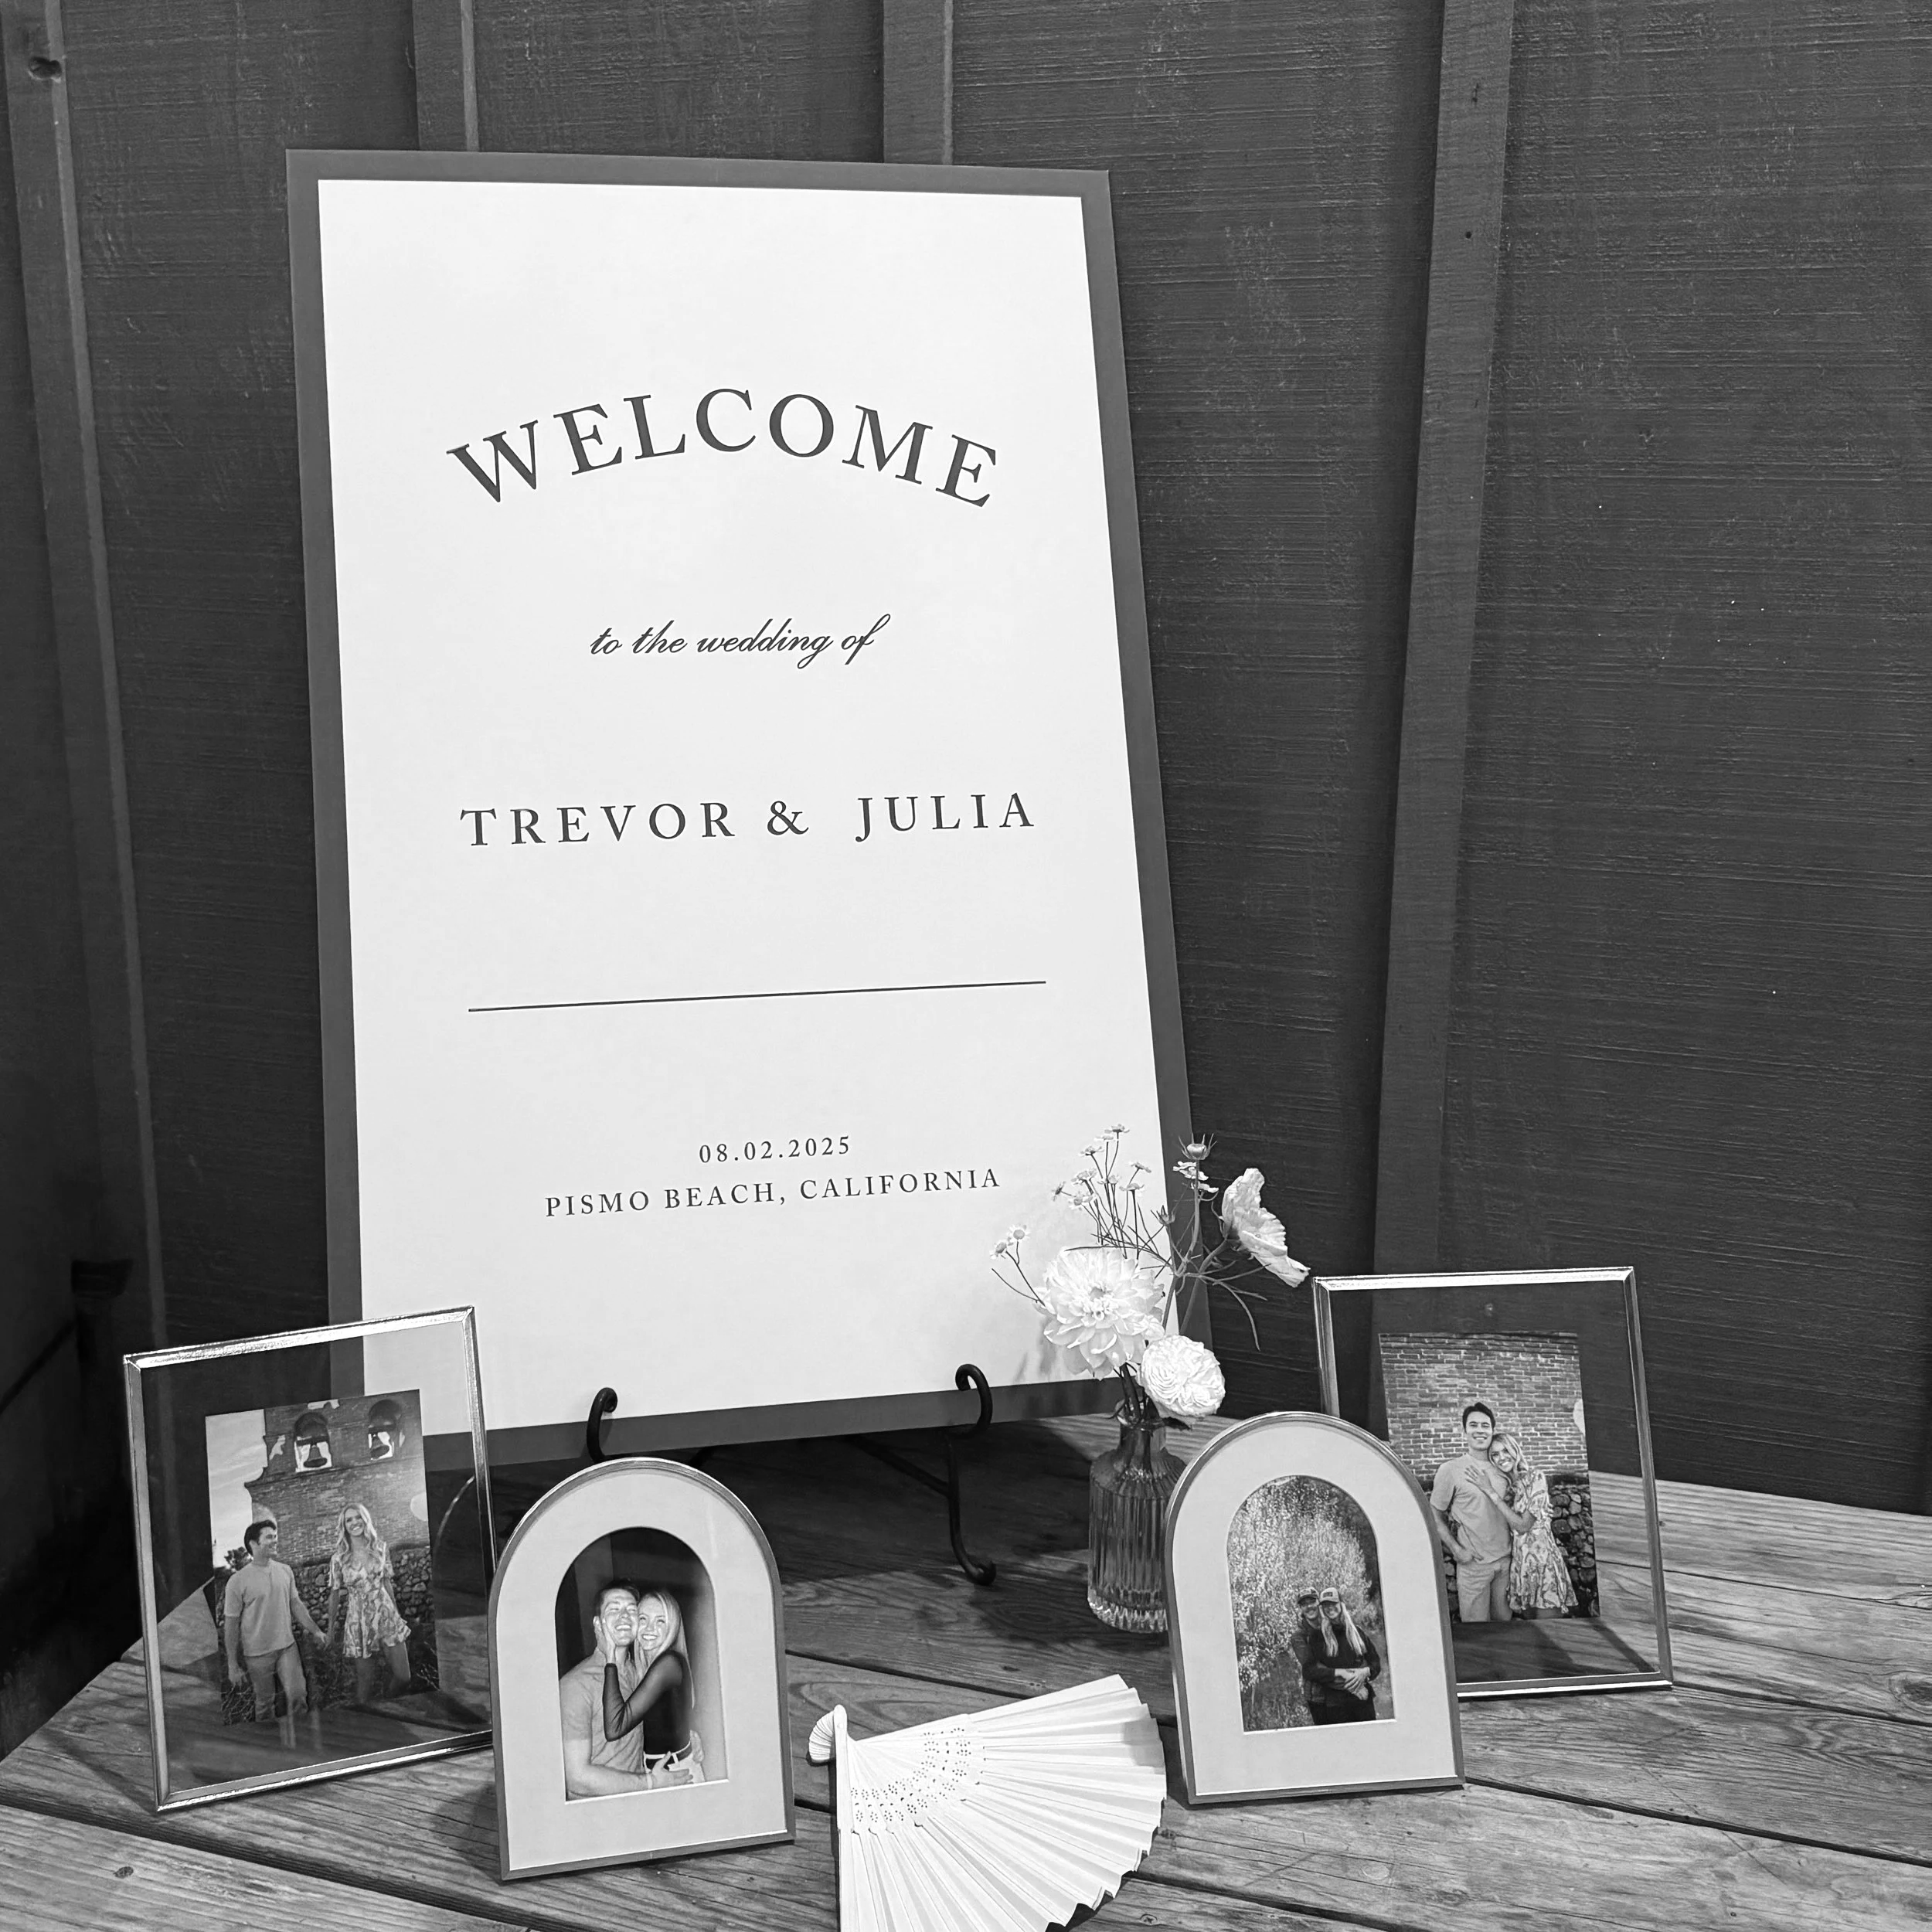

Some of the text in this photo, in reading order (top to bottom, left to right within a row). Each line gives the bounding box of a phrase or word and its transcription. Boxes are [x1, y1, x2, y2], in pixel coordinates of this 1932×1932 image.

[445, 388, 998, 508] WELCOME
[590, 613, 892, 670] to the wedding of
[460, 792, 1036, 847] TREVOR & JULIA
[699, 1135, 850, 1164] 08.02.2025
[546, 1168, 1001, 1218] PISMO BEACH, CALIFORNIA
